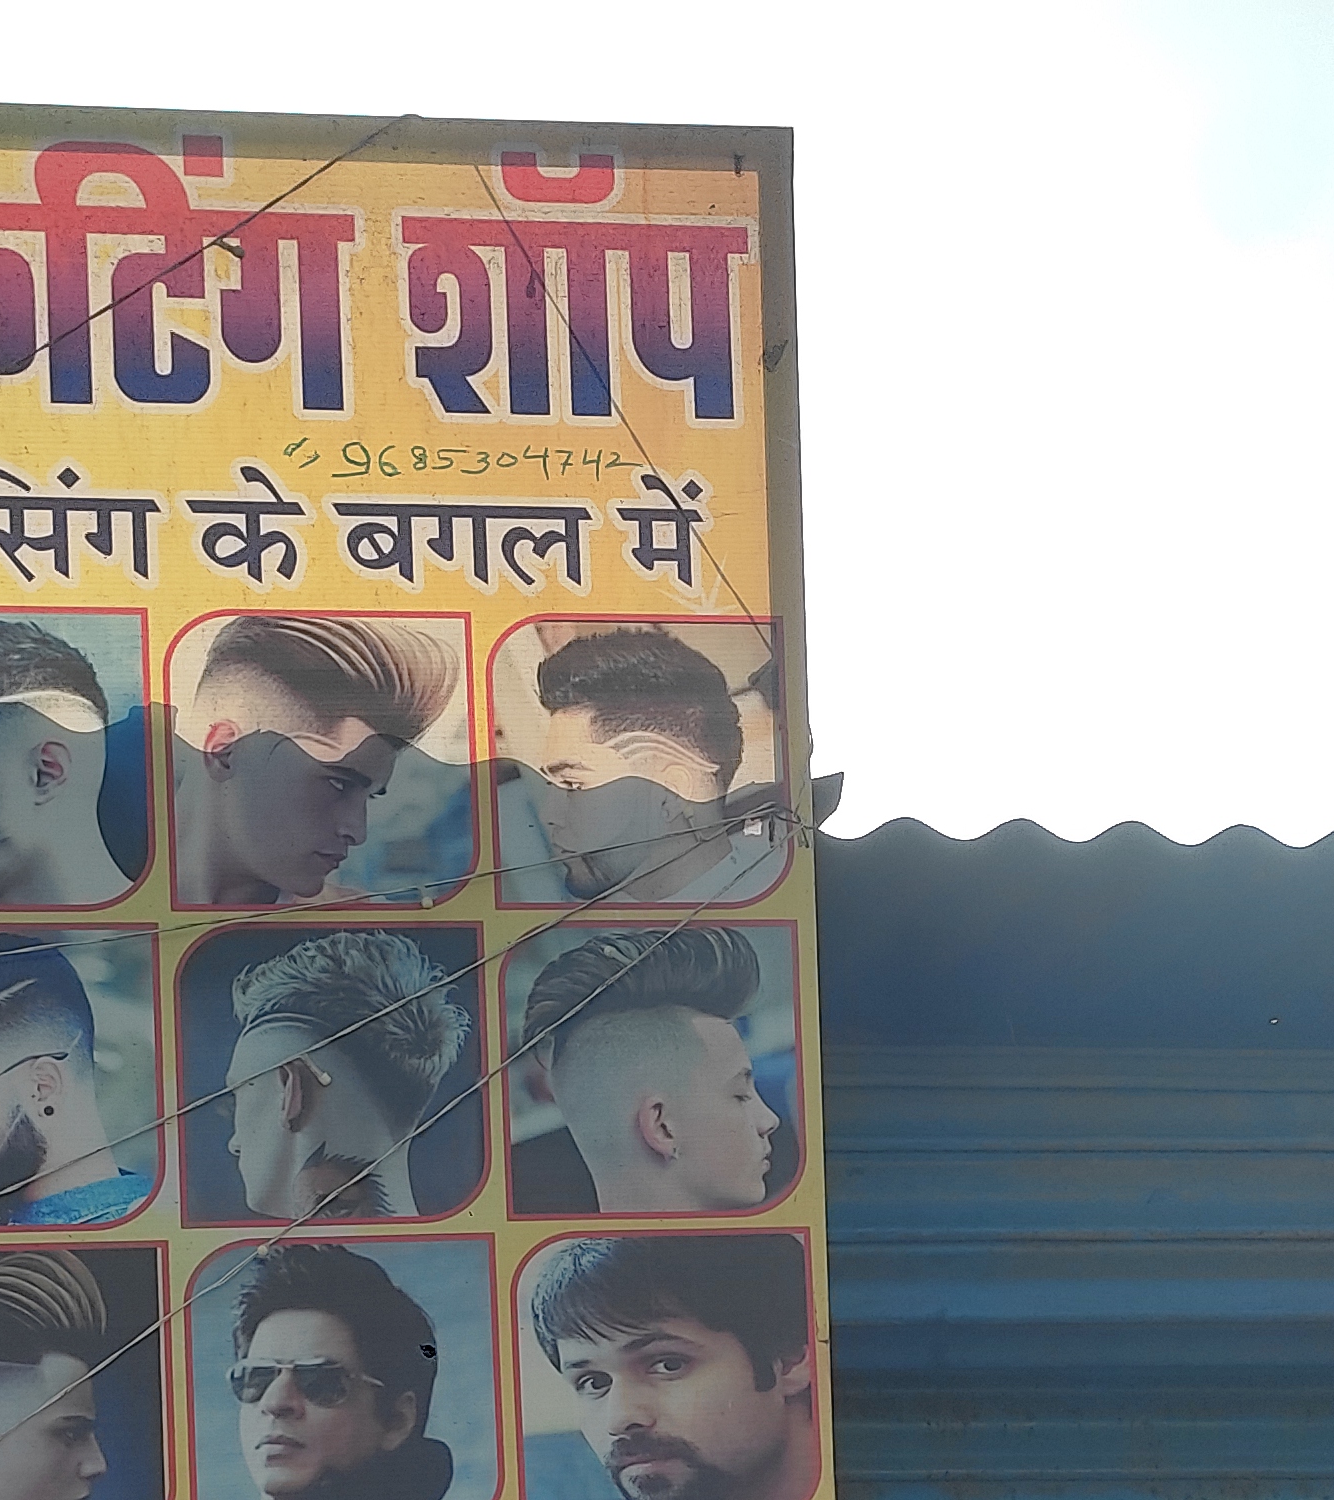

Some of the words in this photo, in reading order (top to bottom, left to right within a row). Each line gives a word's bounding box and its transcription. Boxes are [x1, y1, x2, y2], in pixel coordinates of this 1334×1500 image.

[402, 151, 748, 419] शॉप
[331, 441, 644, 481] 9685304742
[188, 466, 303, 580] के
[334, 503, 589, 585] बगल
[617, 472, 703, 585] में
